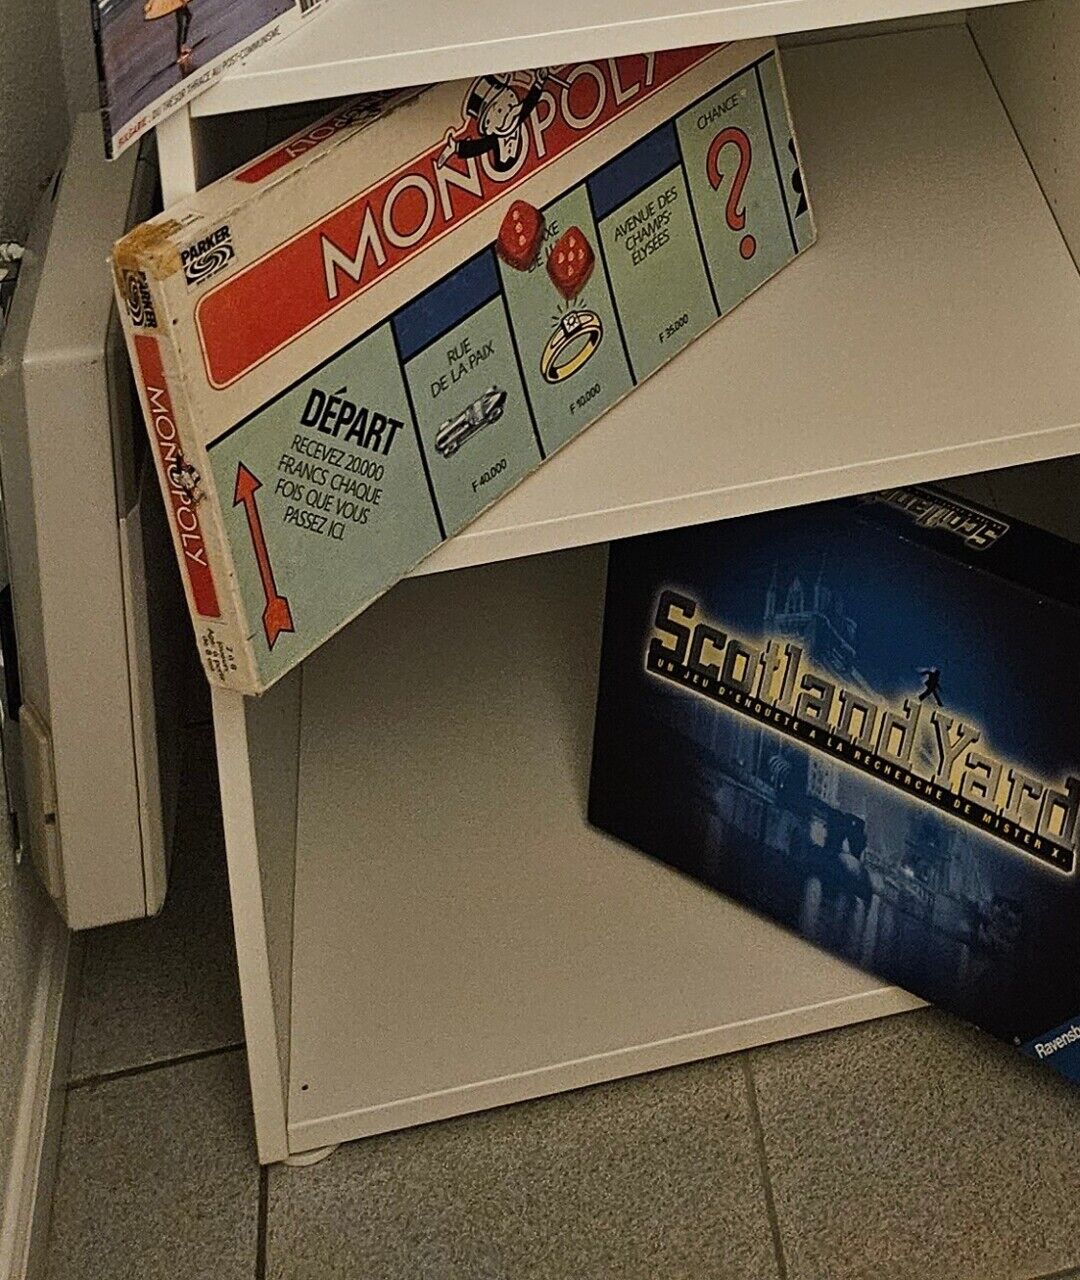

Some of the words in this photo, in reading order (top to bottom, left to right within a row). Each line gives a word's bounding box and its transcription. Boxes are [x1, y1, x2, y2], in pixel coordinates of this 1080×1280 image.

[697, 93, 739, 131] CHANCE
[319, 52, 657, 301] MONOPOLY
[614, 200, 657, 242] AVENUE
[658, 186, 678, 209] DES
[625, 210, 673, 252] CHAMPS-
[181, 225, 231, 266] PARKER
[138, 271, 158, 329] PARKER
[447, 338, 472, 366] RUE
[658, 332, 665, 344] F
[430, 375, 449, 398] DE
[451, 362, 469, 384] LA
[470, 340, 495, 370] PAIX
[300, 386, 405, 456] DÉPART
[570, 404, 577, 415] F
[147, 385, 207, 567] MONOPOLY
[278, 454, 329, 486] FRANCS
[330, 473, 384, 506] CHAQUE
[290, 434, 346, 468] RECEVEZ
[344, 453, 385, 482] 20.000
[275, 478, 305, 502] FOIS
[306, 488, 335, 512] QUE
[336, 497, 371, 525] VOUS
[472, 480, 479, 493] F
[284, 505, 328, 535] PASSEZ
[648, 589, 922, 772] Scotland
[657, 658, 675, 673] UN
[683, 667, 709, 689] JEU
[826, 736, 844, 753] LA
[852, 748, 943, 801] RECHERCHE
[952, 799, 971, 814] DE
[982, 812, 1042, 850] MISTER
